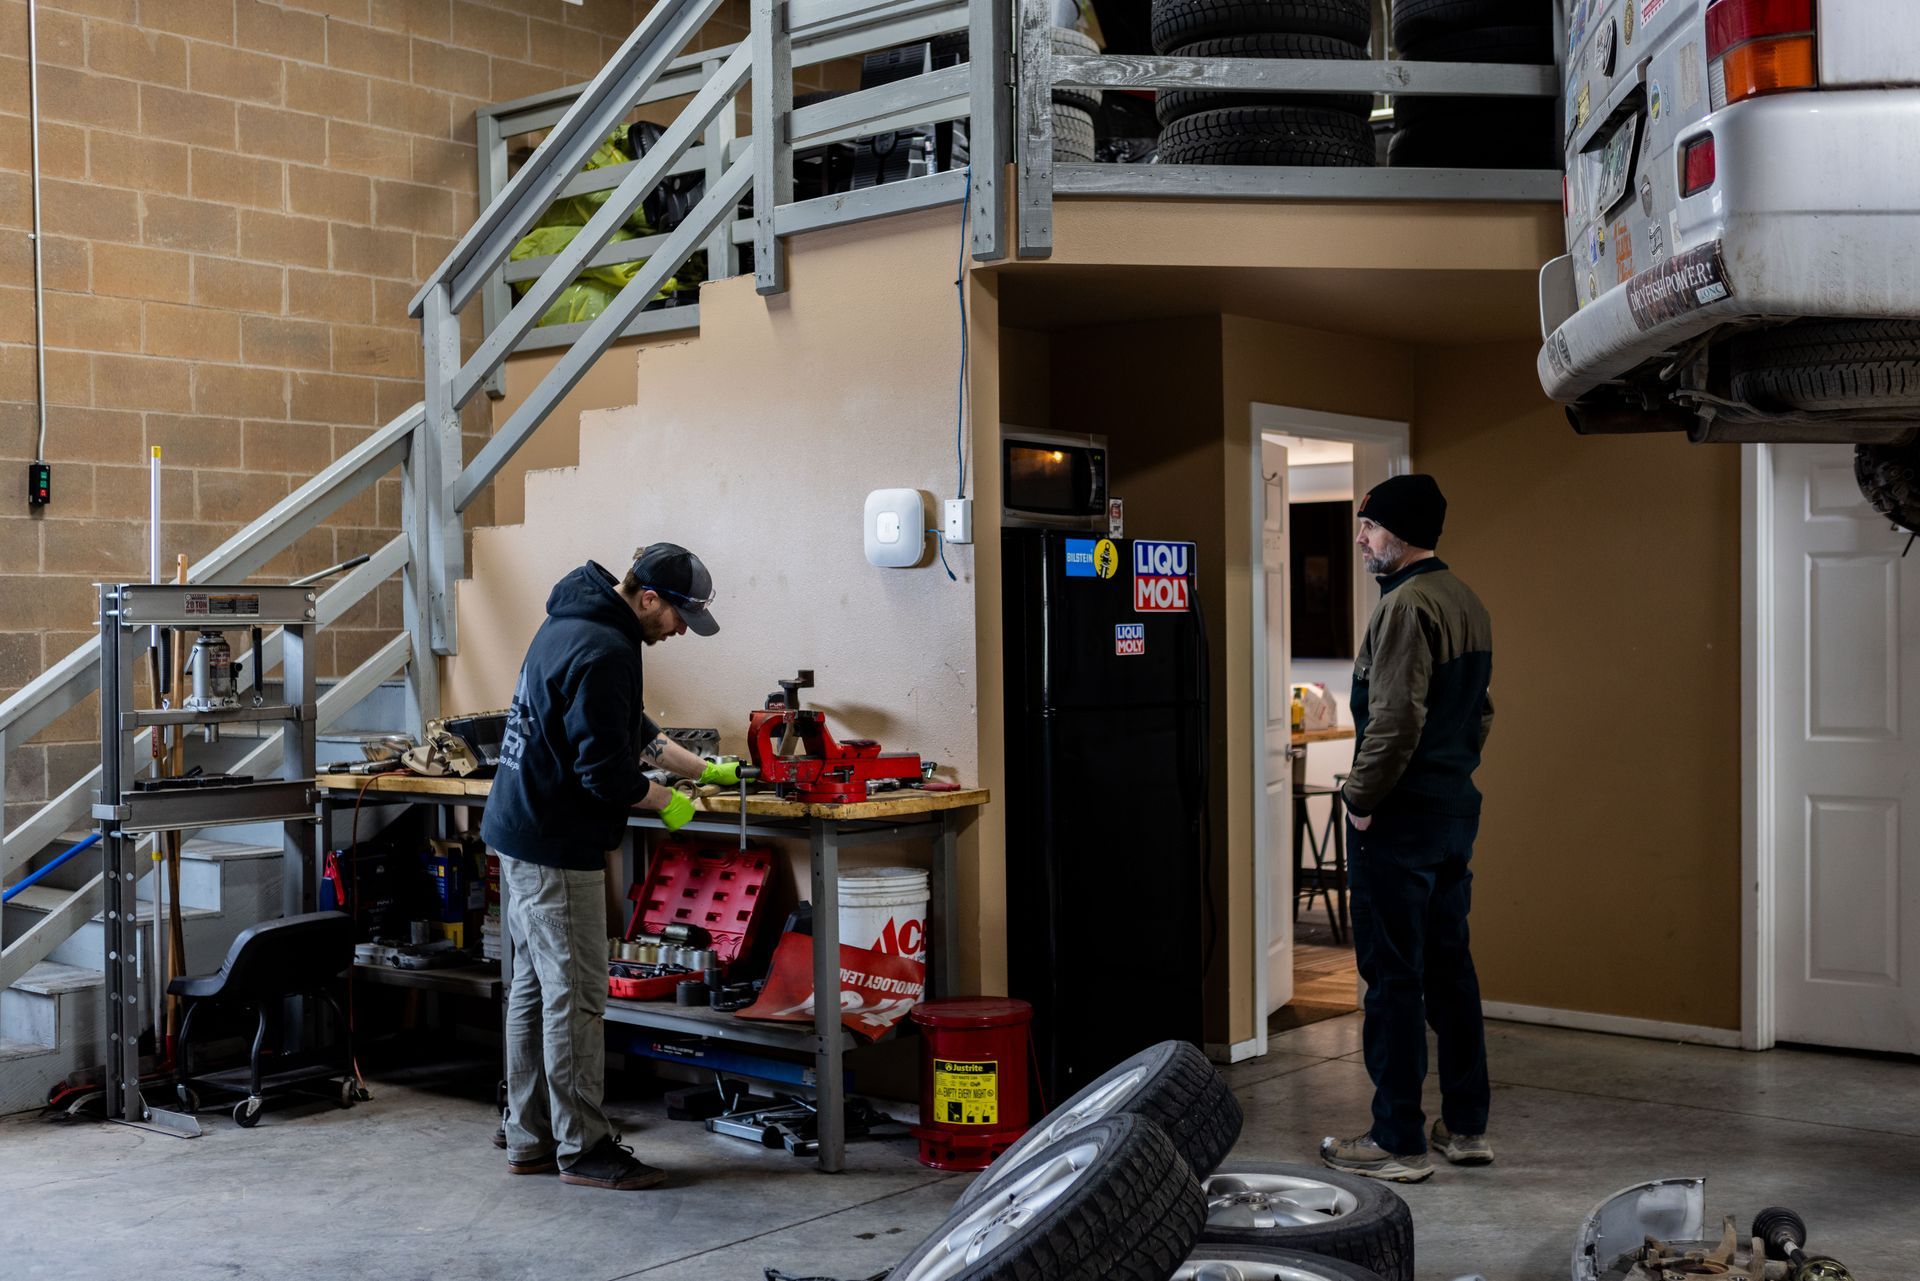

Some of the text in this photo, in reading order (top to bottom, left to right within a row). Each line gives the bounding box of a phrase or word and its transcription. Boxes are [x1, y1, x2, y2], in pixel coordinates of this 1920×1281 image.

[1066, 552, 1093, 563] BILSTEIN
[1137, 544, 1187, 576] LIQU
[186, 600, 195, 608] 20
[195, 600, 208, 609] TON
[1117, 626, 1142, 640] LIQUI
[1118, 639, 1144, 653] MOLY
[865, 975, 923, 995] HNOLOGY
[953, 1063, 983, 1071] Justrite
[943, 1087, 986, 1098] EMPTY EVERY NIGHT
